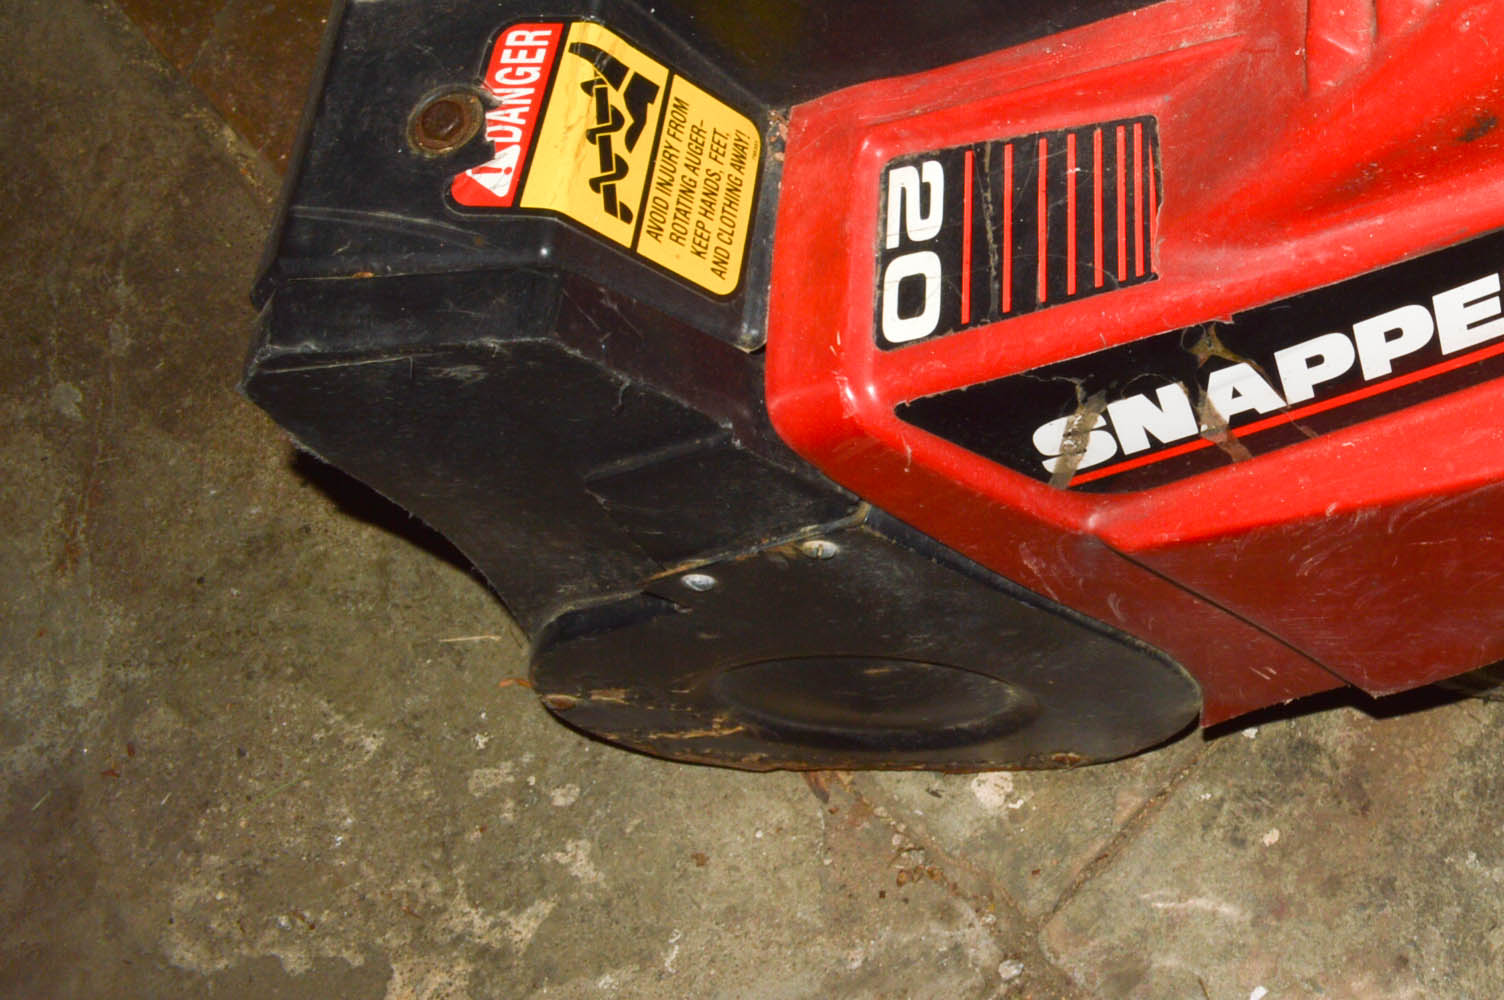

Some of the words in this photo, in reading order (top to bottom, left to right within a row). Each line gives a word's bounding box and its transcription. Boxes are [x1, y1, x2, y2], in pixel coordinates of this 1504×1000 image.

[485, 30, 552, 142] DANGER
[666, 96, 689, 142] FROM
[655, 140, 680, 197] INJURY
[730, 129, 750, 175] AWAY!
[646, 196, 669, 243] AVOID
[669, 175, 697, 246] ROTATING
[698, 168, 723, 221] HANDS,
[717, 174, 743, 245] CLOTHING
[690, 220, 711, 260] KEEP
[710, 246, 730, 280] AND
[882, 160, 945, 344] 20
